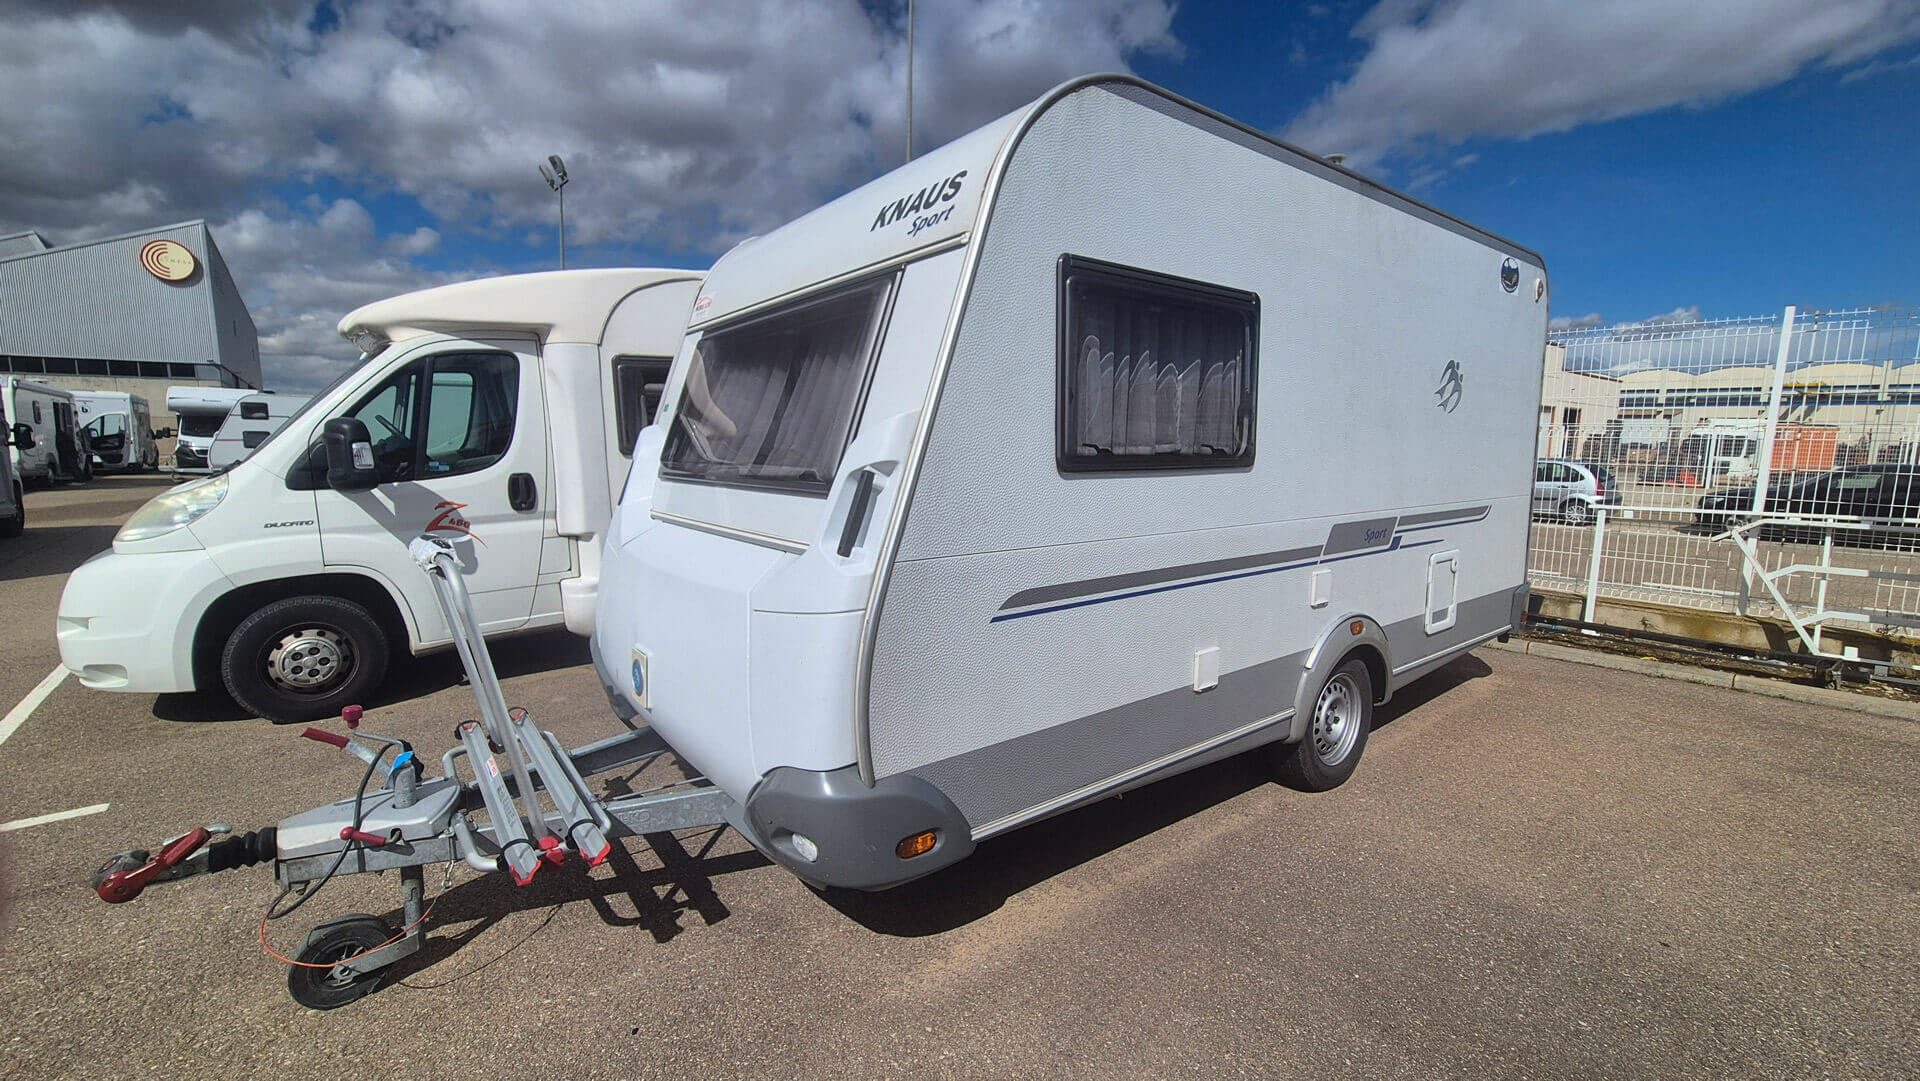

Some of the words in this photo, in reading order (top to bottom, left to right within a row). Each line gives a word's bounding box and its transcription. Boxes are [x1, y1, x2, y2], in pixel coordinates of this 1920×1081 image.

[869, 169, 968, 232] KNAUS
[906, 204, 955, 238] Sport
[263, 519, 314, 529] DUCATO
[1364, 527, 1388, 544] Sport
